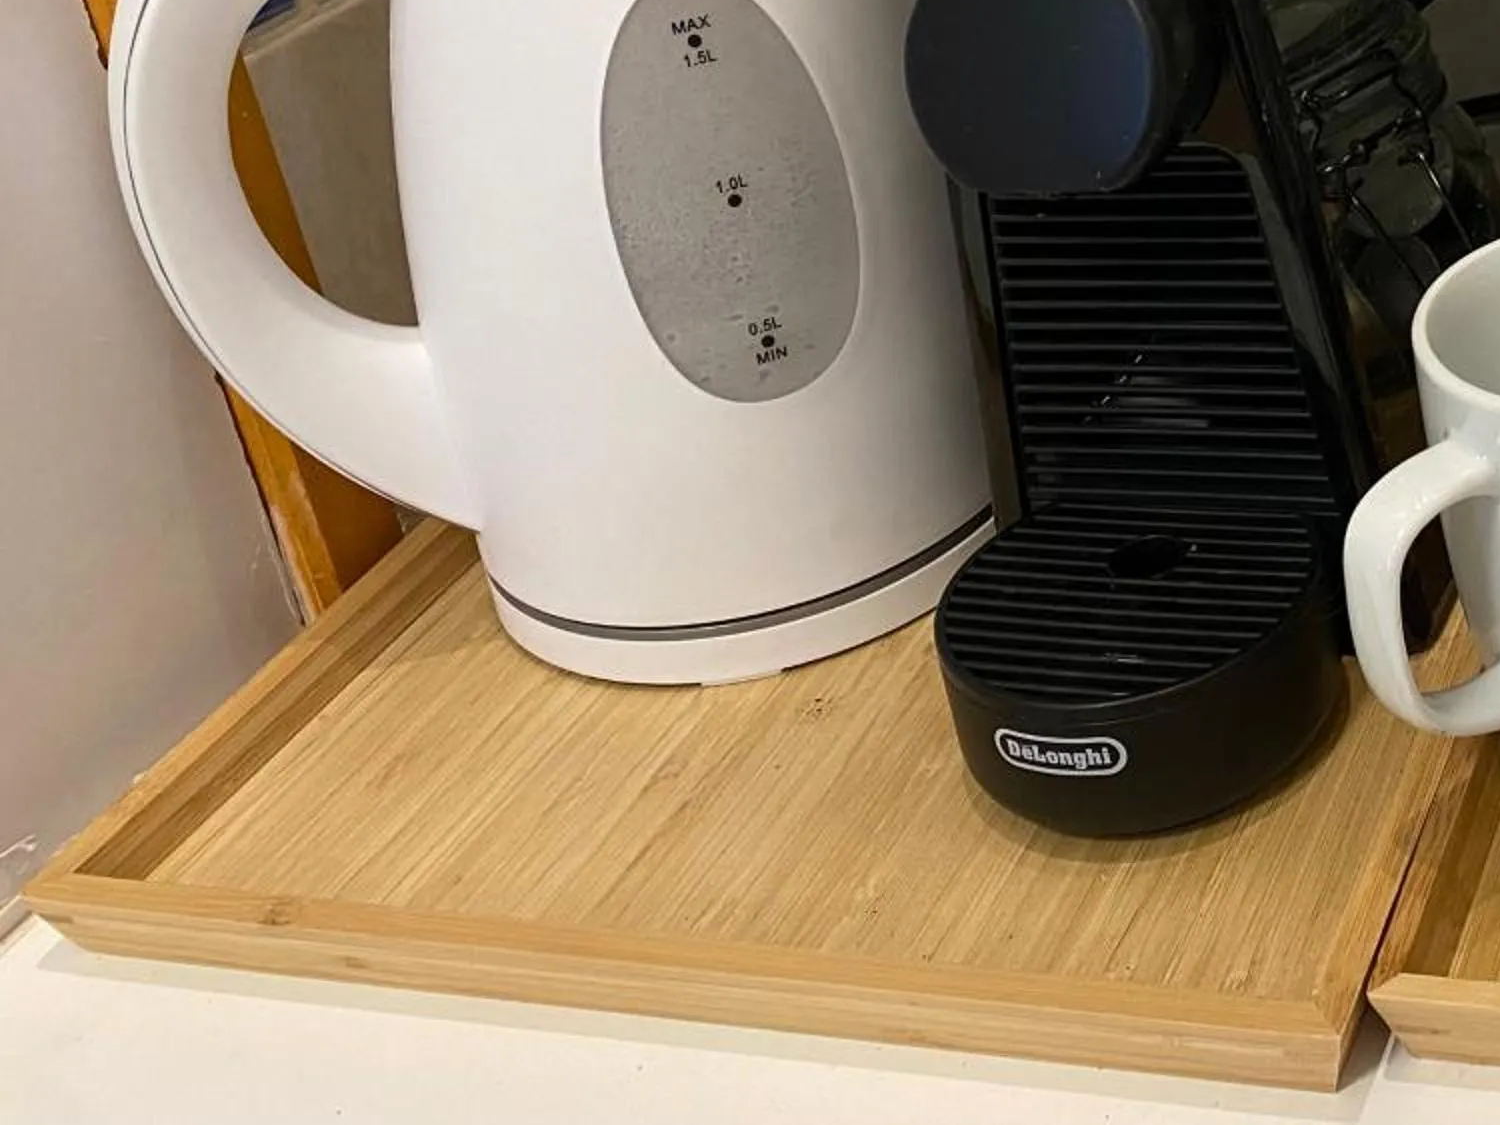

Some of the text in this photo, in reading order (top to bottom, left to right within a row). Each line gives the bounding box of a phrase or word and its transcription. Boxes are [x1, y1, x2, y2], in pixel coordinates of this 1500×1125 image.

[671, 14, 711, 35] MAX
[684, 49, 718, 67] 1.5L
[716, 174, 748, 193] 1.0L
[748, 316, 782, 336] 0.5L
[756, 346, 788, 365] MIN
[1006, 738, 1112, 769] DeLonghi
